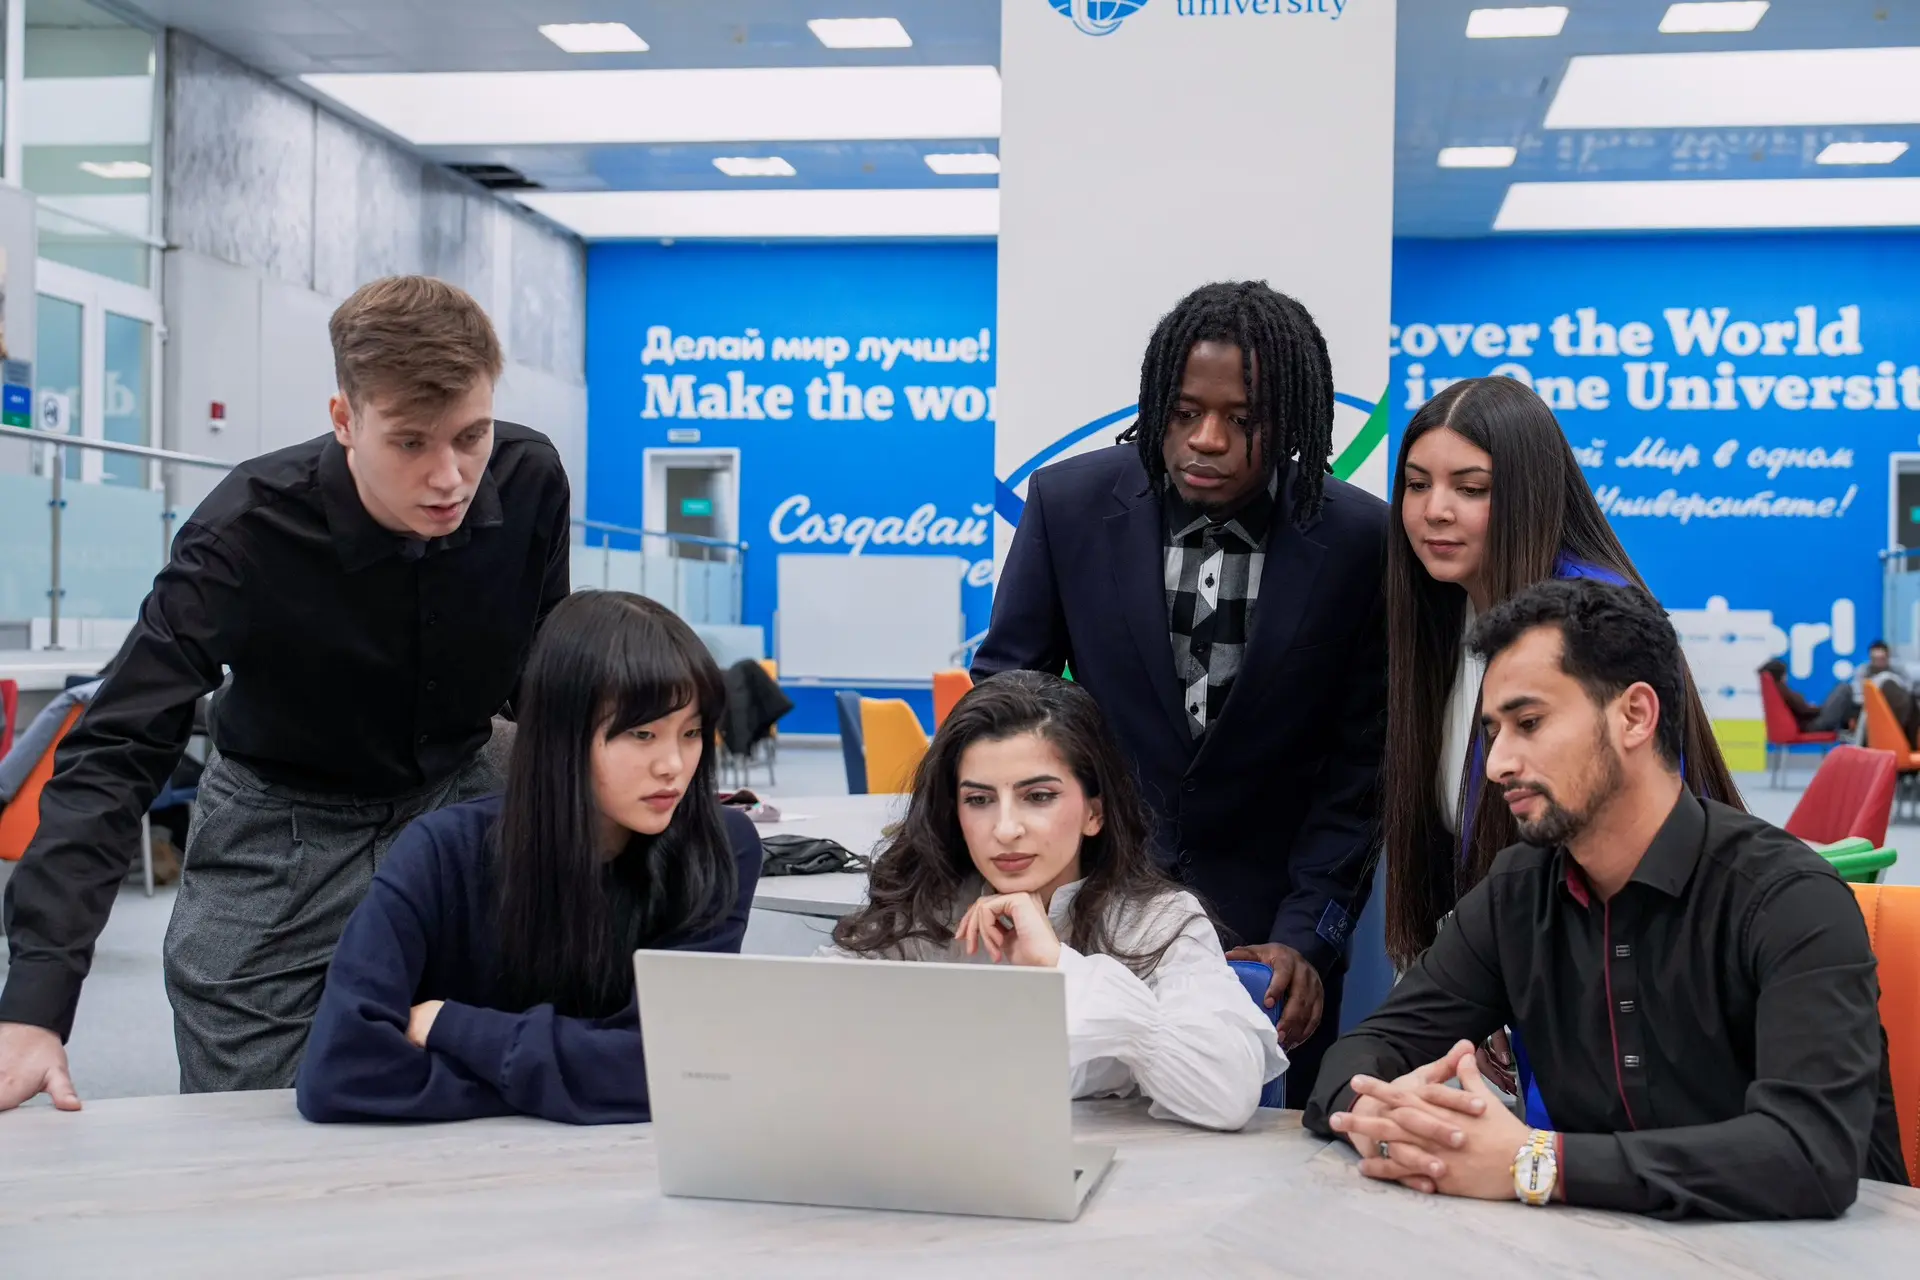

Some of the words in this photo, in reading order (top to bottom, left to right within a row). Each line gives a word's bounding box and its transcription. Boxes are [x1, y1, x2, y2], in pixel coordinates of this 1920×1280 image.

[641, 325, 765, 366] Делай
[771, 335, 850, 369] мир
[855, 327, 991, 372] лучше!
[1549, 306, 1654, 357] the
[1663, 304, 1863, 357] World
[640, 370, 794, 420] Make
[805, 371, 895, 421] the
[1615, 436, 1699, 475] Мир
[1746, 446, 1854, 480] одном
[768, 493, 994, 560] Создавай
